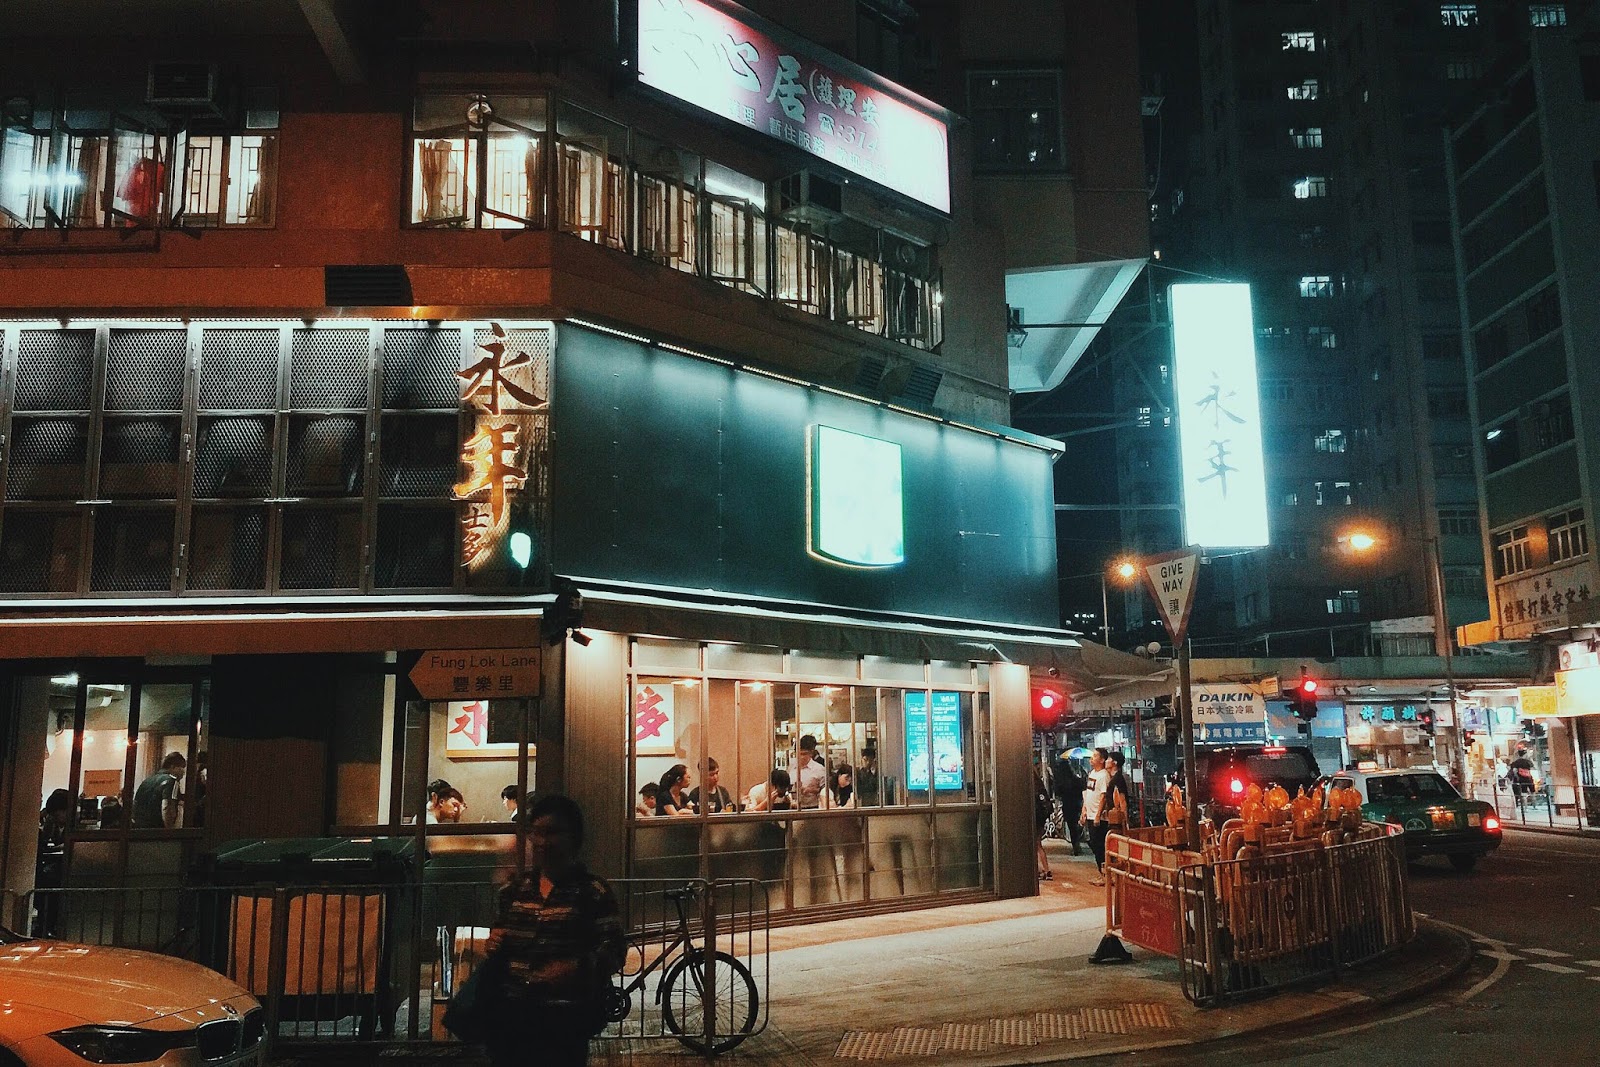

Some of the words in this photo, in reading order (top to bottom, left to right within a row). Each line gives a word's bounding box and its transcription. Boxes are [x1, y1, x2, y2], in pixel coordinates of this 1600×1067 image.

[453, 322, 549, 528] 永年
[1194, 370, 1247, 501] 永年
[1160, 562, 1184, 578] GIVE
[1162, 578, 1184, 593] WAY
[431, 655, 465, 670] Fung
[469, 655, 496, 668] Lok
[501, 655, 537, 667] Lane
[452, 675, 514, 693] 豐樂里
[1143, 699, 1153, 707] 12
[1199, 692, 1254, 702] DAIKIN
[1197, 704, 1254, 715] 日本大金冷氣
